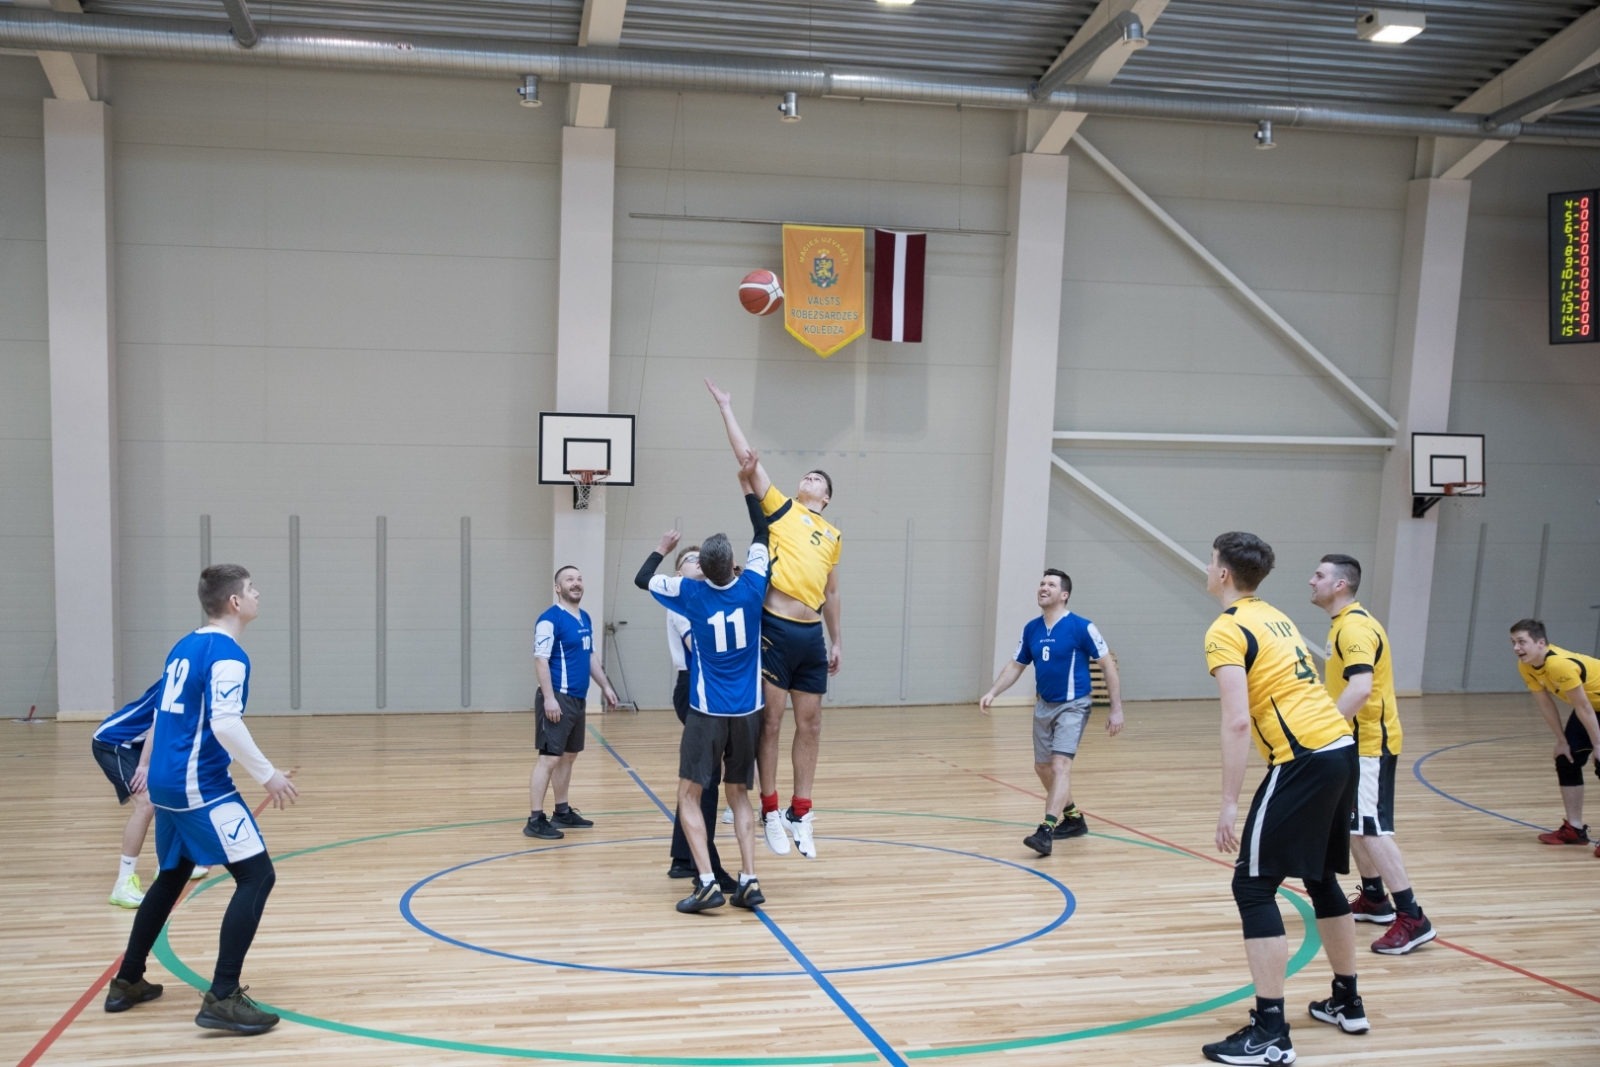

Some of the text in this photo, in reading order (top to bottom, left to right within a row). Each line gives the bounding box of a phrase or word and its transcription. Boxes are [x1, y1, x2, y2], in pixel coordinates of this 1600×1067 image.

[807, 296, 841, 306] VALSTS
[810, 530, 823, 546] 5
[707, 607, 747, 653] 11
[1264, 621, 1294, 638] VIP
[582, 635, 591, 651] 10
[1042, 645, 1051, 662] 6
[1294, 645, 1318, 684] 4
[160, 658, 190, 714] 12
